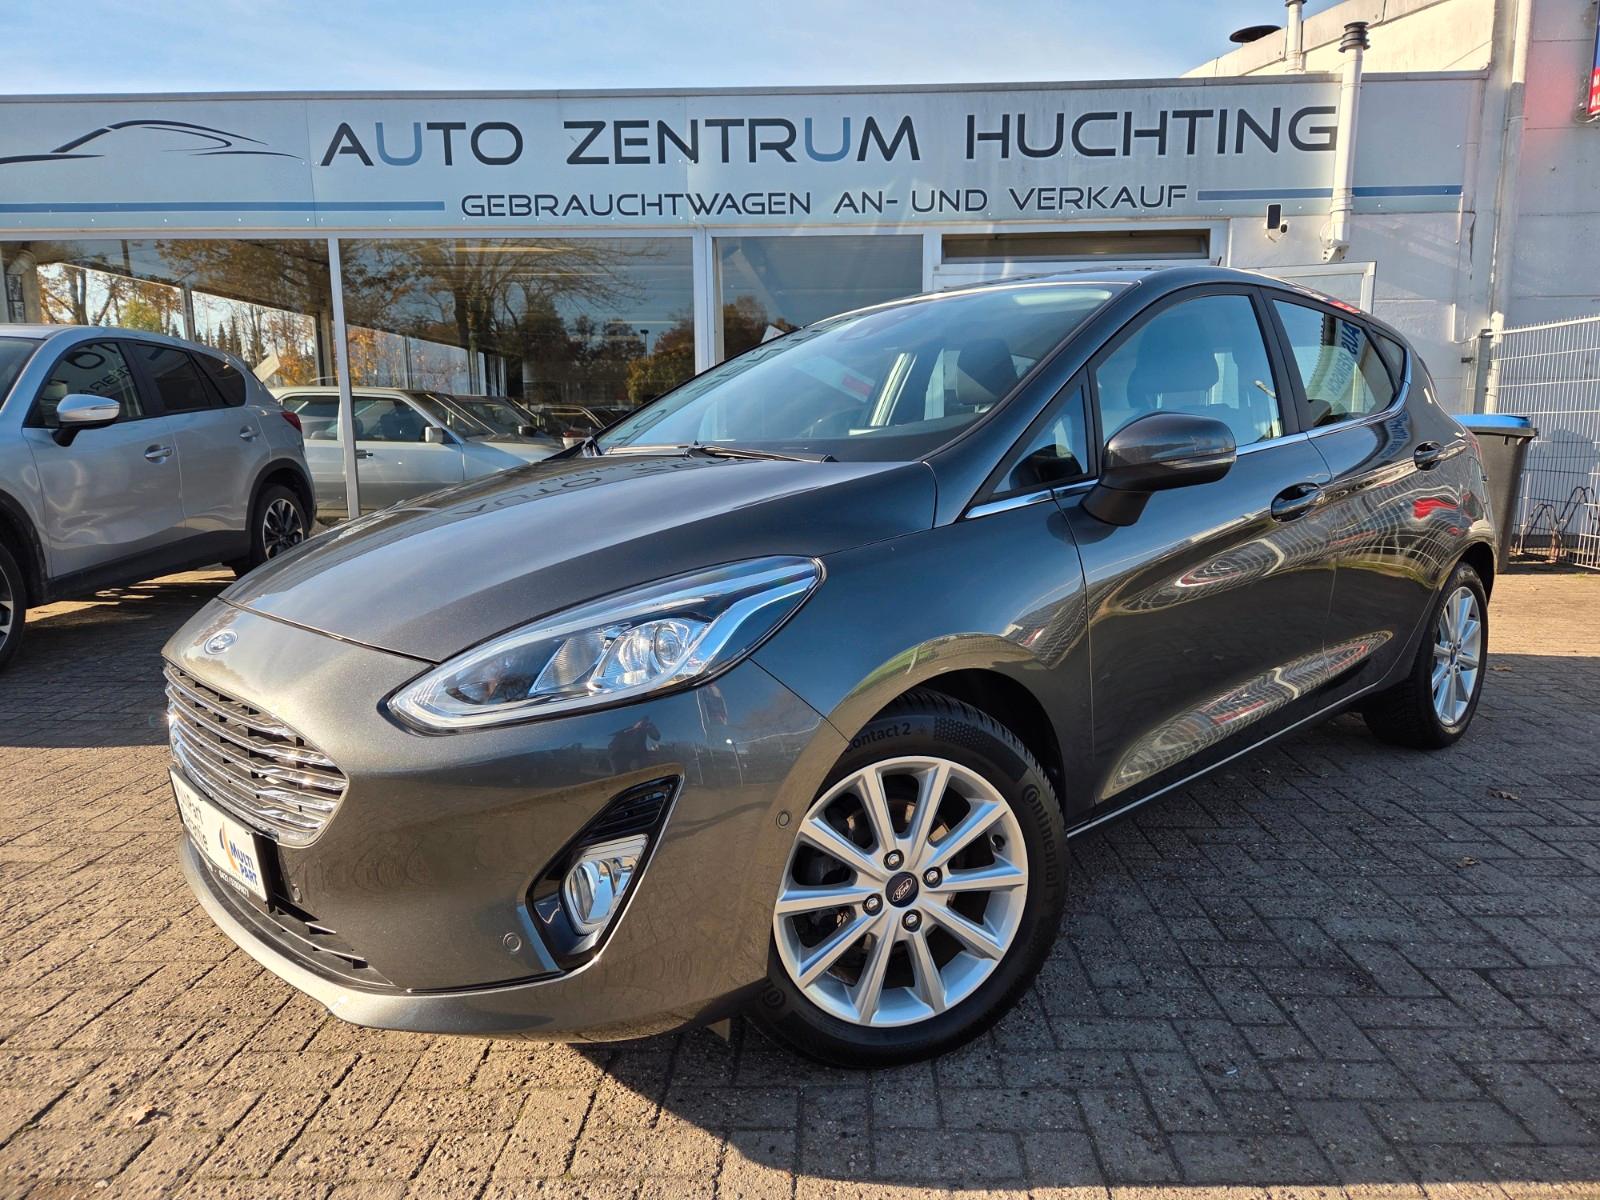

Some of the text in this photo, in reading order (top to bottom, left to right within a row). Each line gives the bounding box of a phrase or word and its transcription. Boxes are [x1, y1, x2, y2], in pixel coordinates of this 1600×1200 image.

[321, 106, 1337, 167] AUTO ZENTRUM HUCHTING
[461, 184, 1188, 217] GEBRAUCHTWAGEN AN- UND VERKAUF
[901, 722, 912, 736] 2
[1021, 783, 1060, 886] Continental
